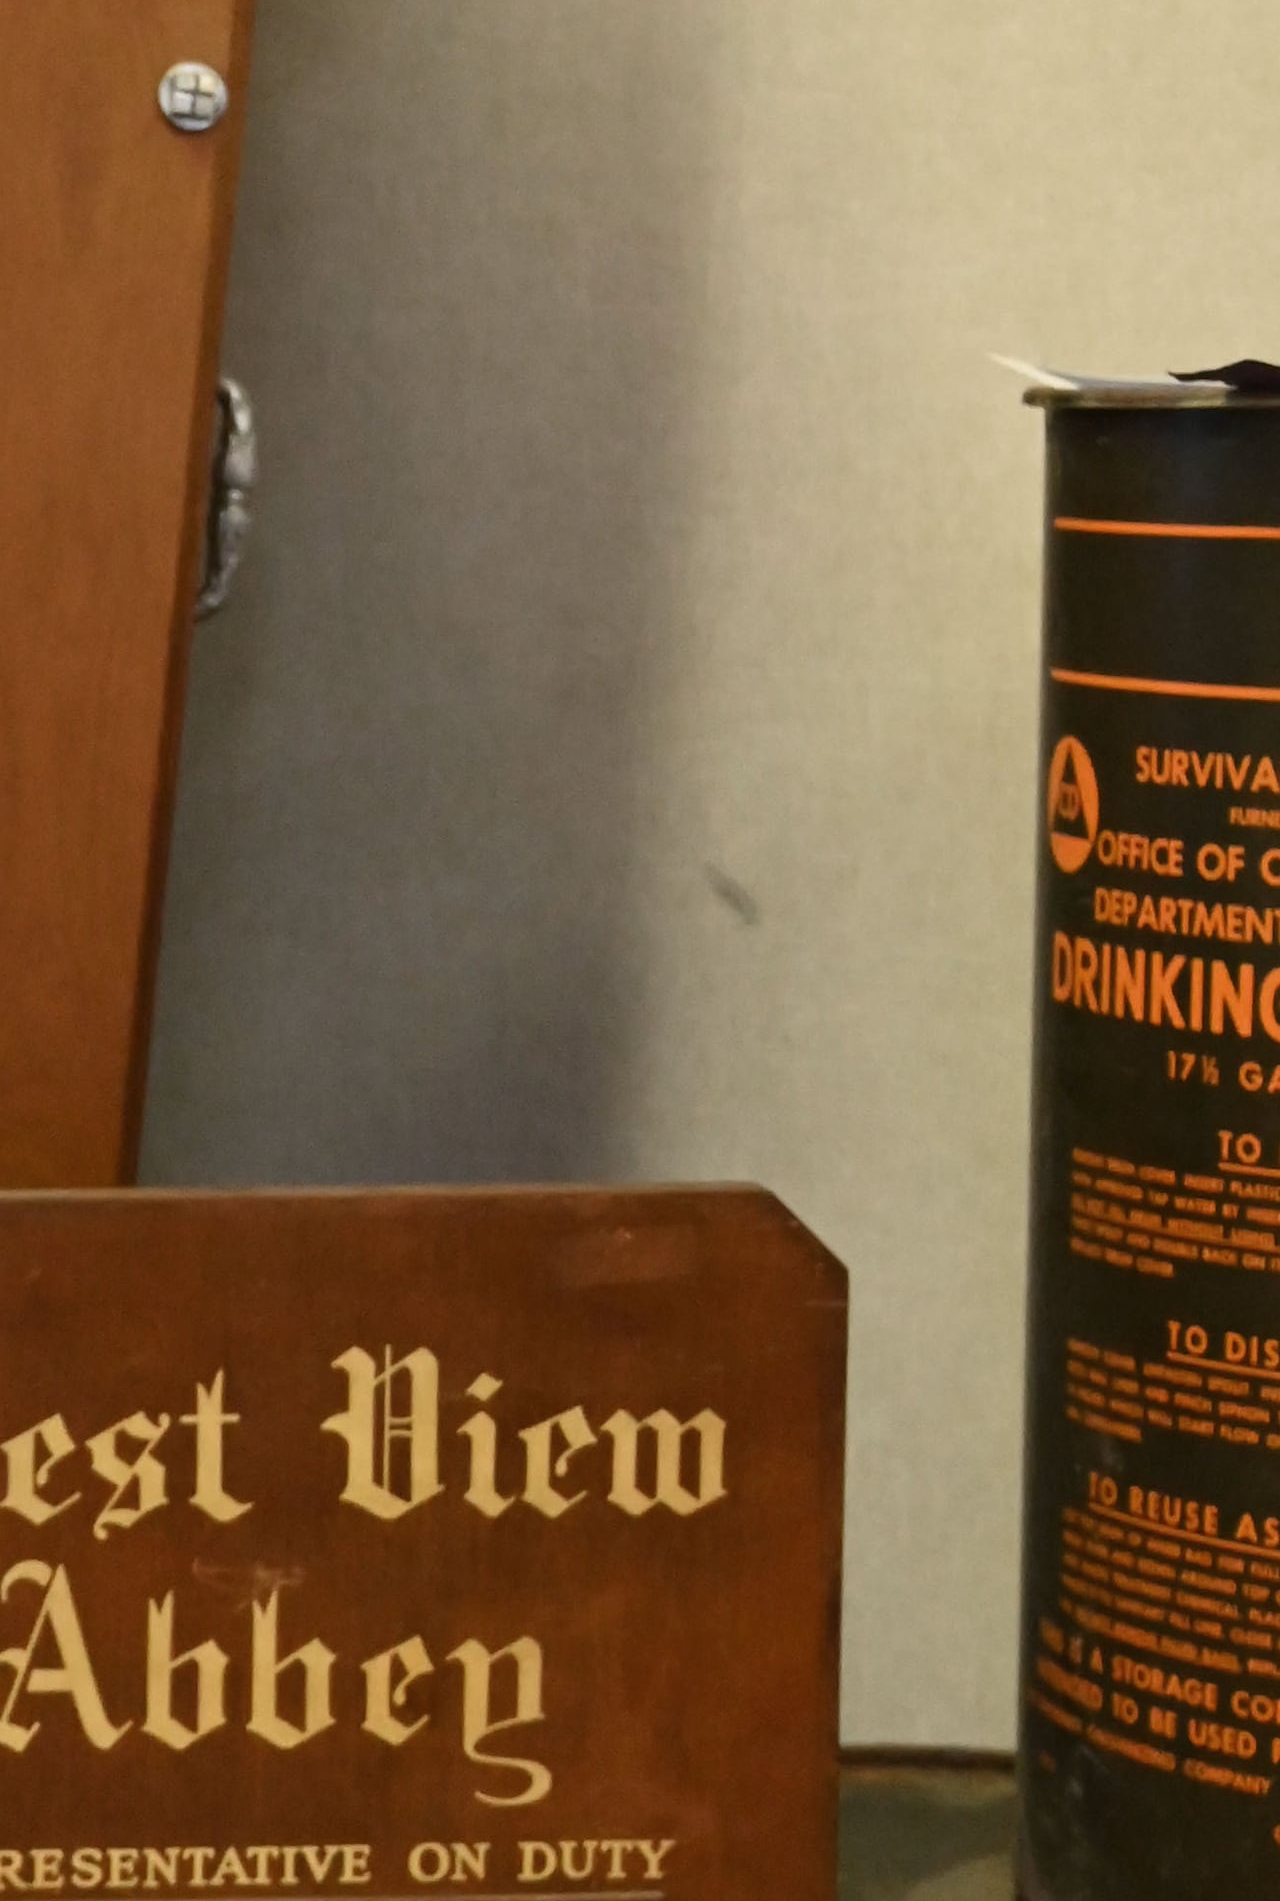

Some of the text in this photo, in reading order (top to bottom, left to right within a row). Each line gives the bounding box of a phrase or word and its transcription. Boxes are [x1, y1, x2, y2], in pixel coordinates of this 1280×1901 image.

[1097, 828, 1185, 878] OFFICE
[1196, 842, 1245, 883] OF
[1094, 885, 1280, 945] DEPARTMEN
[1217, 1129, 1262, 1165] TO
[1166, 1319, 1209, 1356] TO
[320, 1343, 728, 1520] View
[1088, 1470, 1118, 1507] TO
[1129, 1485, 1219, 1537] REUSE
[1112, 1652, 1220, 1713] STORAGE
[1230, 1689, 1280, 1726] CO
[1187, 1717, 1257, 1760] USED
[407, 1841, 490, 1884] ON
[517, 1838, 676, 1884] DUTY
